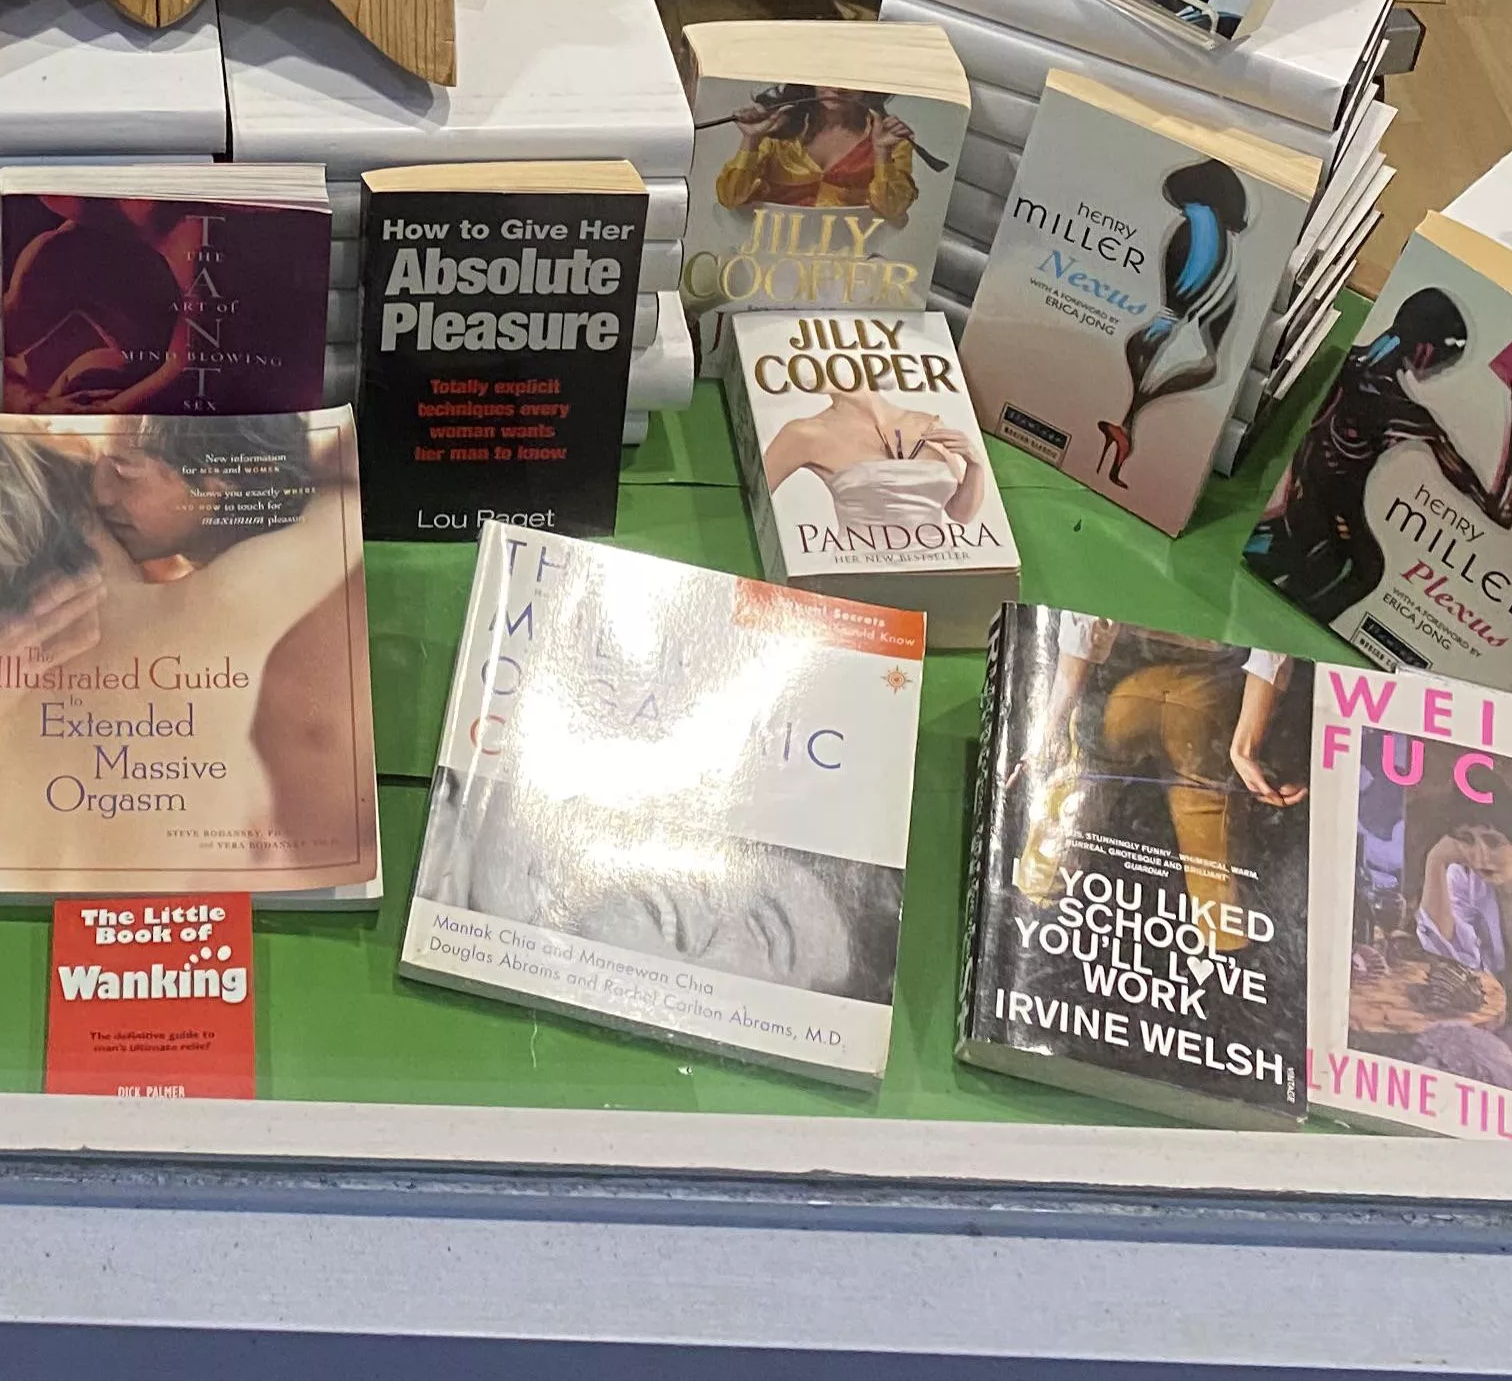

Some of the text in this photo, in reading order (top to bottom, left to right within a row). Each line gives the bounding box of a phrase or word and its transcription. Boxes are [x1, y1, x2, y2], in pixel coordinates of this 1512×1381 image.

[383, 219, 634, 241] How to Give Her
[741, 210, 885, 258] JILLY
[385, 248, 620, 296] Absolute
[685, 255, 918, 309] COOPER
[1035, 248, 1148, 316] Nexus
[381, 302, 619, 352] Pleasure
[1045, 296, 1116, 336] ERICA JONG
[789, 318, 904, 351] JILLY
[122, 349, 284, 368] MIND BLOWING
[754, 355, 960, 394] COOPER
[183, 399, 217, 411] SEX
[431, 379, 560, 398] Totally explicit
[418, 401, 569, 420] techniques every
[430, 425, 555, 440] woman wants
[205, 453, 286, 463] New information
[415, 446, 567, 462] her man know
[238, 501, 265, 511] touch
[246, 487, 280, 498] exactly
[202, 516, 264, 526] maximum
[418, 510, 467, 529] Lou
[797, 522, 1002, 554] PANDORA
[864, 550, 970, 565] NEW BESTSELLER
[1402, 559, 1509, 647] Plexus
[881, 631, 915, 646] Know
[1383, 593, 1420, 626] ERICA
[1415, 620, 1452, 652] JONG
[149, 656, 249, 691] Guide
[39, 702, 194, 738] Extended
[94, 745, 227, 780] Massive
[46, 775, 186, 818] Orgasm
[1086, 833, 1139, 850] STUNNINGLY
[1109, 847, 1161, 865] GROTESQUE
[1124, 862, 1169, 878] GUARDIAN
[81, 905, 226, 926] The Little
[1058, 867, 1274, 944] YOU LIKED
[96, 924, 213, 945] Book of
[1014, 918, 1153, 975] YOU'LL
[1057, 896, 1237, 970] SCHOOL,
[433, 914, 715, 996] Mantak Chia Maneewan Chia
[58, 963, 247, 1003] Wanking
[429, 935, 723, 1021] Douglas Abrams Carlton
[1082, 961, 1207, 1021] WORK
[114, 1032, 164, 1041] definitive
[130, 1044, 177, 1052] ultimate
[995, 988, 1284, 1085] IRVINE WELSH
[118, 1086, 185, 1098] DICK PALMER
[1285, 1066, 1297, 1104] VINTAGE
[1307, 1048, 1438, 1118] LYNNE
